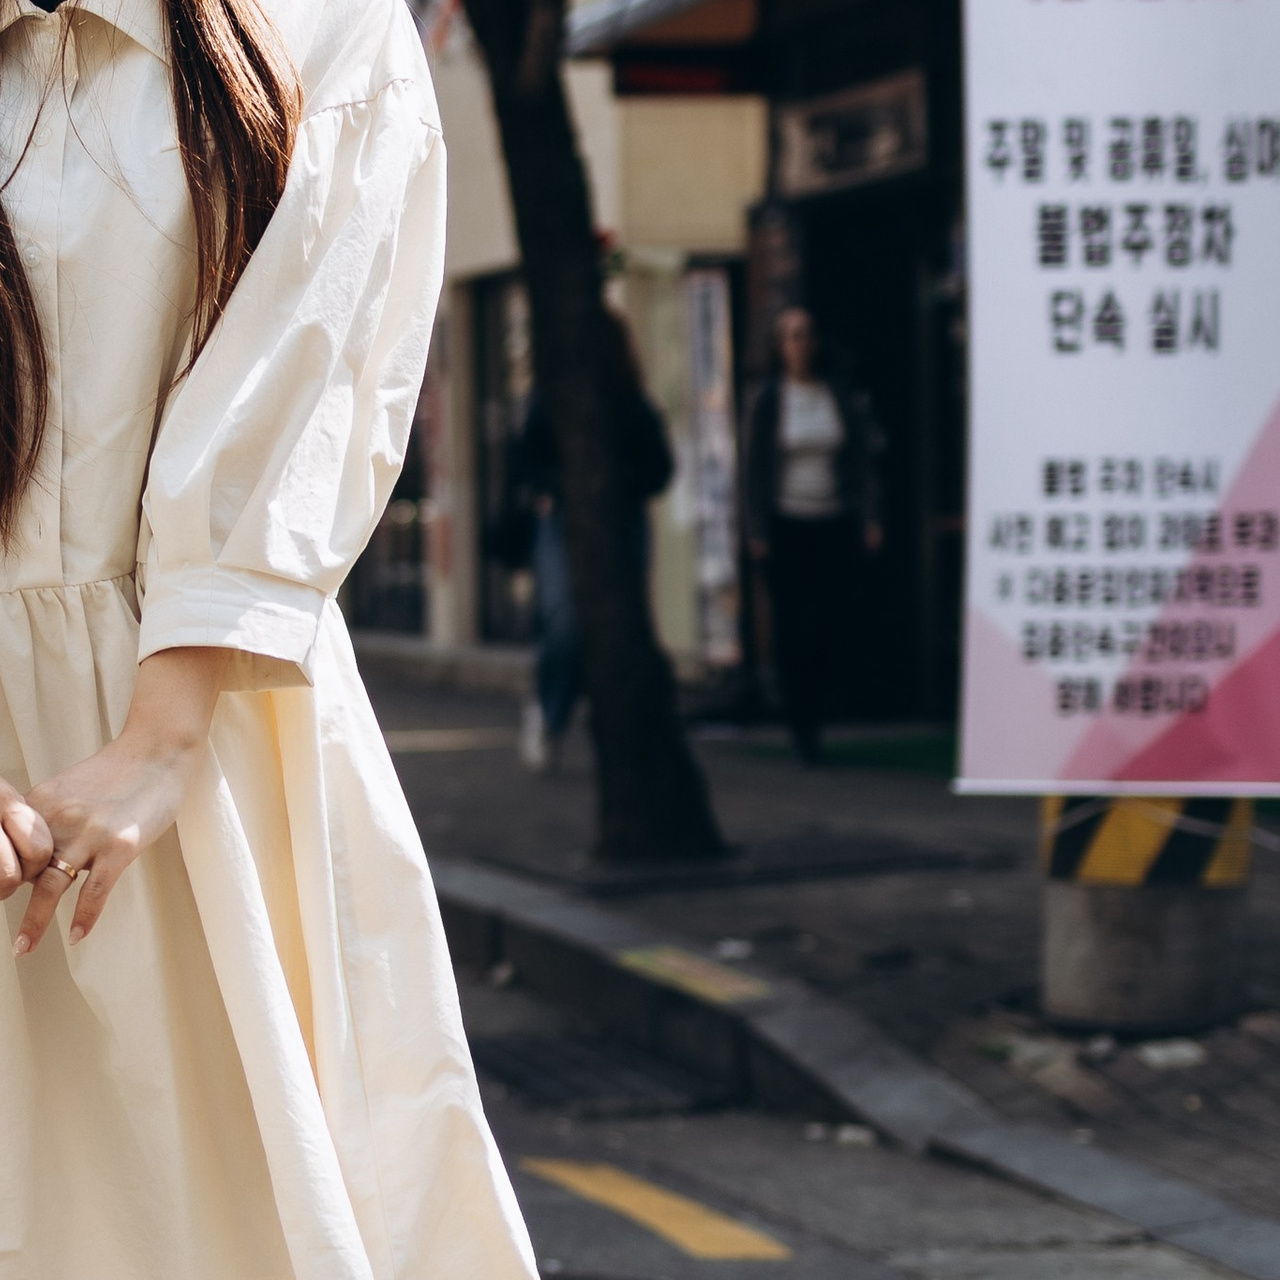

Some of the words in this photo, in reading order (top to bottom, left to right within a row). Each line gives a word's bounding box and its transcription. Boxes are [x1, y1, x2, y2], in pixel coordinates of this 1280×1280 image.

[985, 117, 1045, 184] 주말
[1036, 202, 1234, 268] 불법주정차
[1049, 287, 1125, 354] 단속
[1149, 287, 1222, 354] 실시
